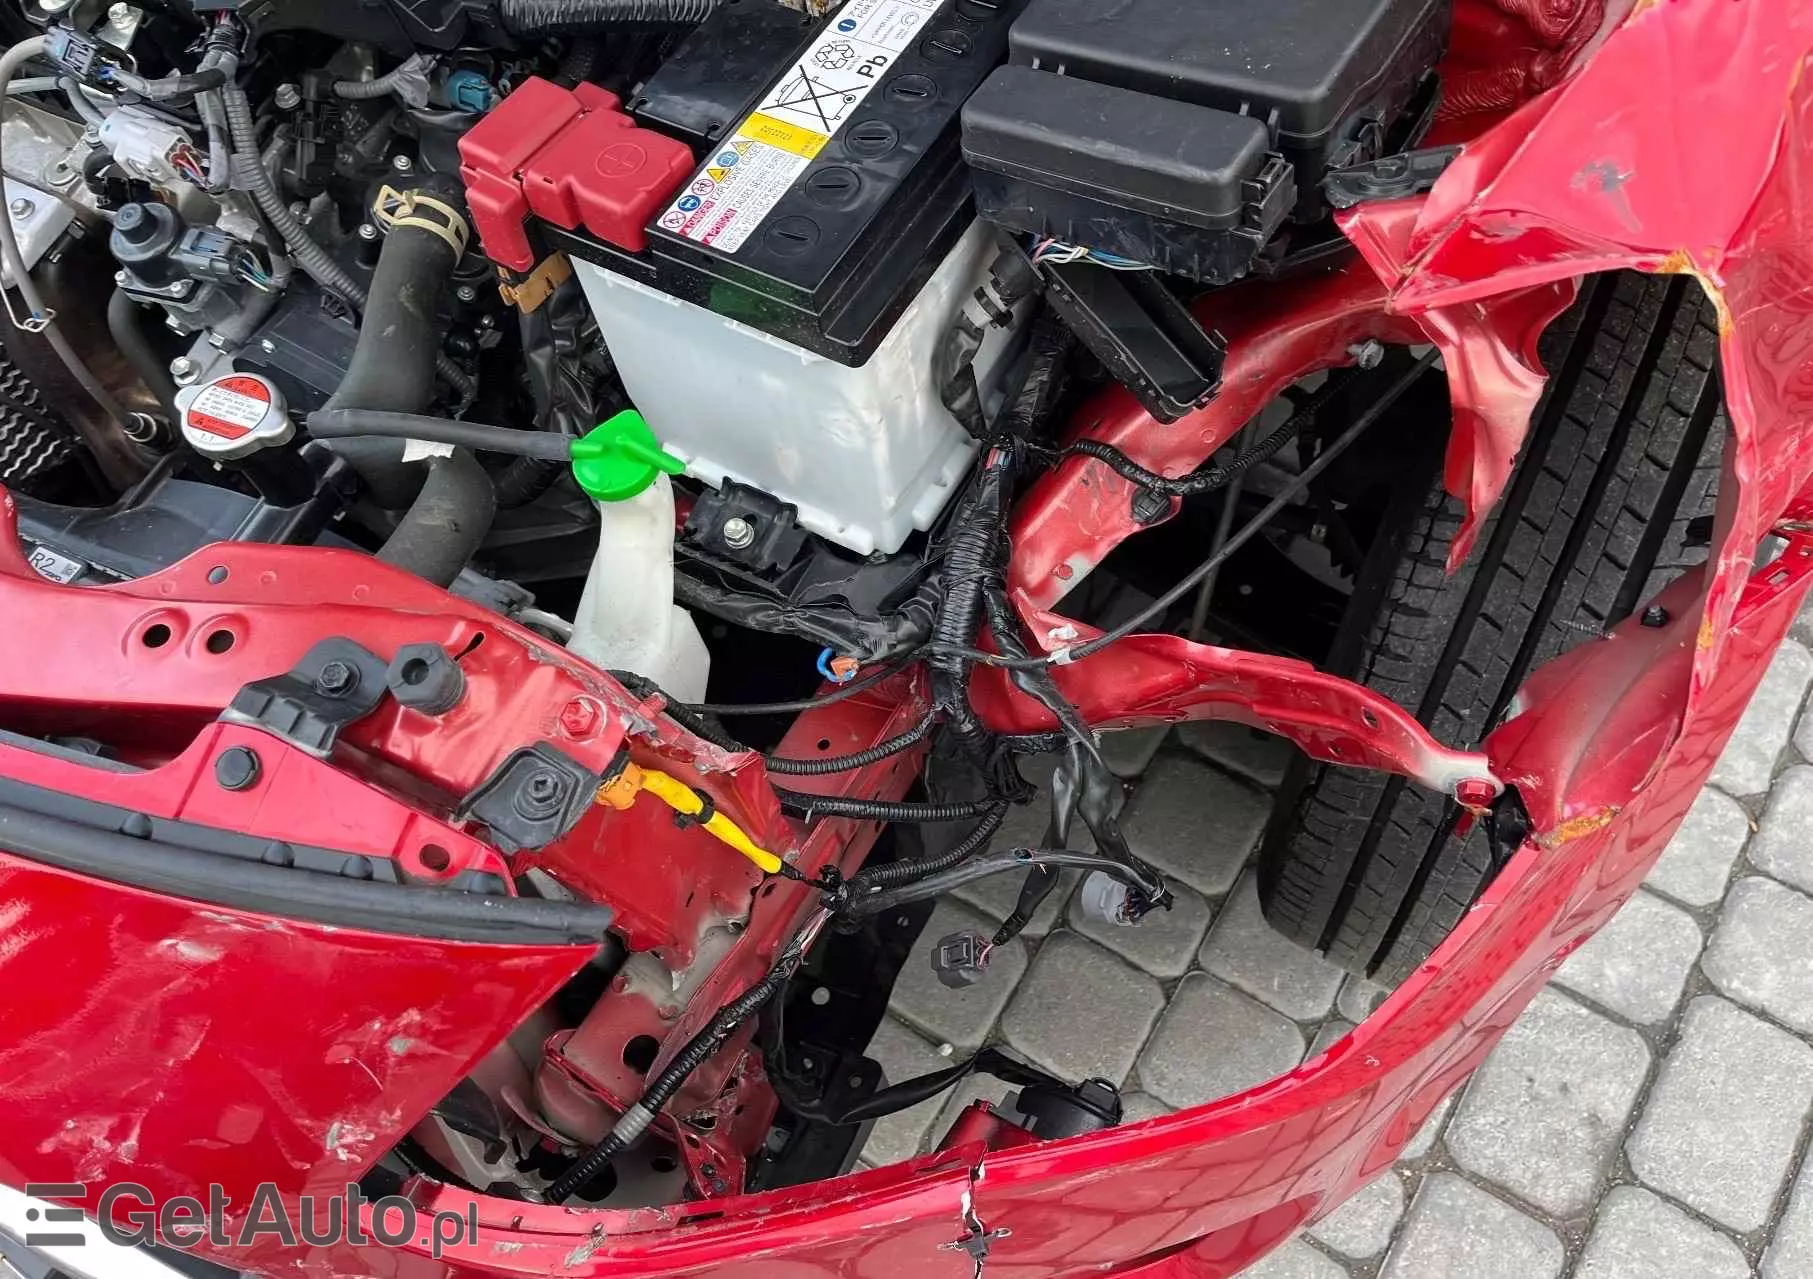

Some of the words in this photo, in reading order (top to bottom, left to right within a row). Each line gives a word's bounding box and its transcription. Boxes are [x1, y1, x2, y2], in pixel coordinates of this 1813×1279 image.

[856, 55, 888, 78] Pb
[686, 199, 715, 227] DANGER
[709, 164, 746, 201] EXPLOSIVE
[708, 209, 736, 236] POISON
[749, 168, 771, 188] SEVERE
[765, 151, 786, 169] BURNS
[31, 552, 55, 571] R2
